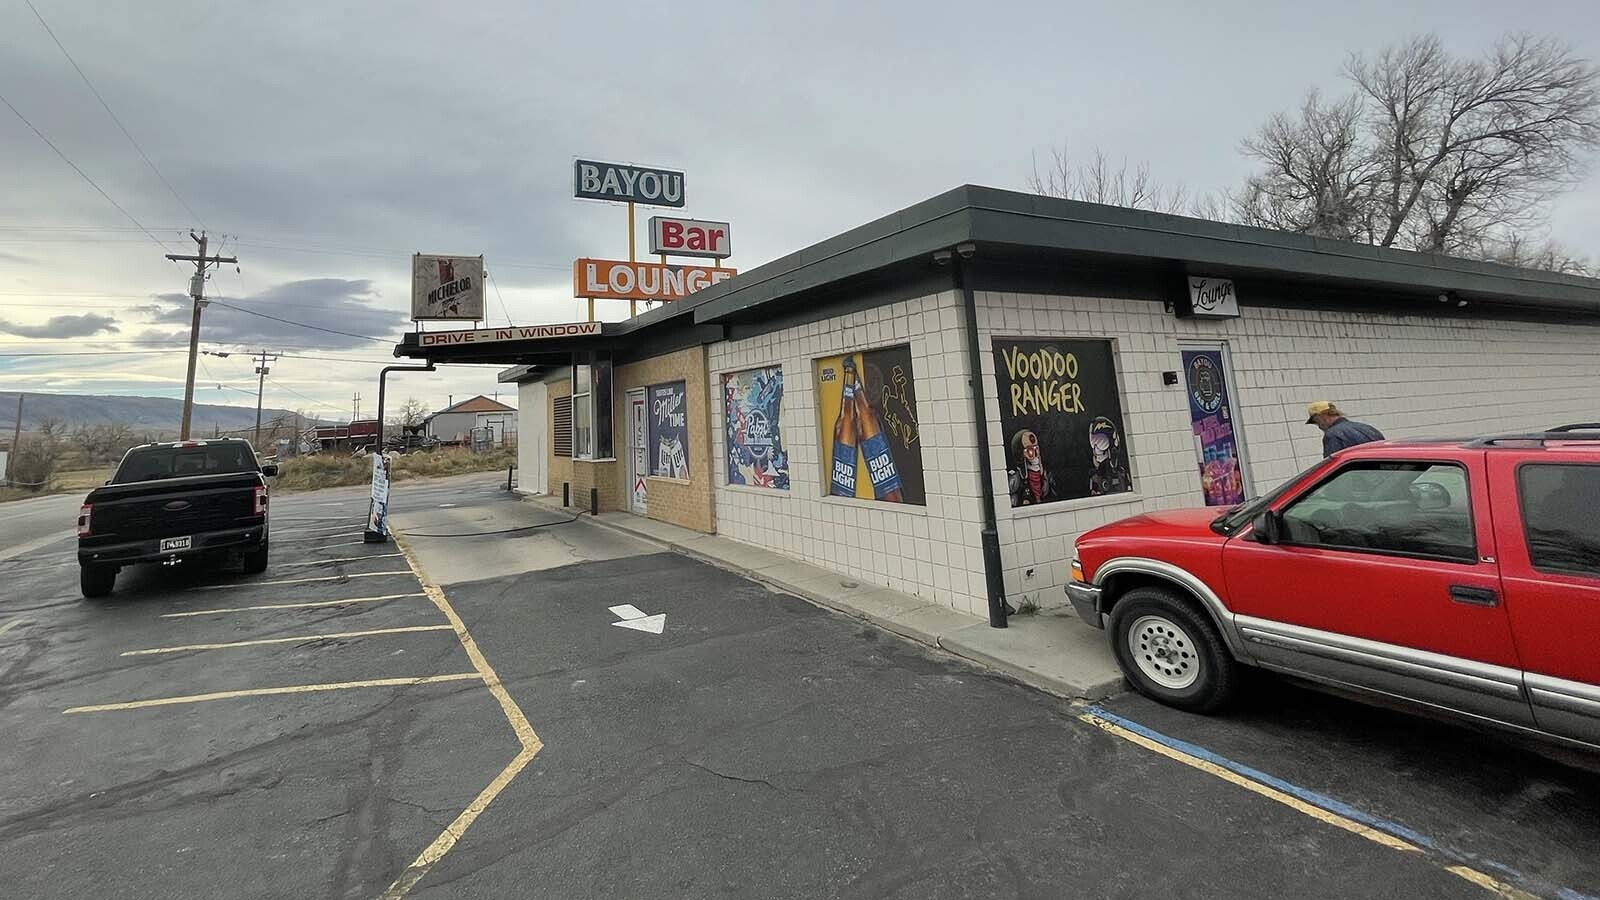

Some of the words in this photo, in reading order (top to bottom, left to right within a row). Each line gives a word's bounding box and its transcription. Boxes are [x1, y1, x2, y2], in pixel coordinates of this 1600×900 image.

[581, 164, 681, 202] BAYOU
[662, 221, 724, 251] Bar
[428, 276, 471, 306] MICHELOB
[1192, 280, 1232, 311] Lounge
[422, 333, 475, 345] DRIVE
[496, 330, 513, 340] IN
[519, 324, 597, 338] WINDOW
[1002, 346, 1078, 380] VOODOO
[653, 391, 684, 427] Miller
[1010, 380, 1085, 416] RANGER
[669, 412, 685, 427] TIME
[835, 460, 853, 477] BUD
[869, 453, 890, 472] BUD
[871, 462, 896, 484] LIGHT
[832, 470, 855, 489] LIGHT
